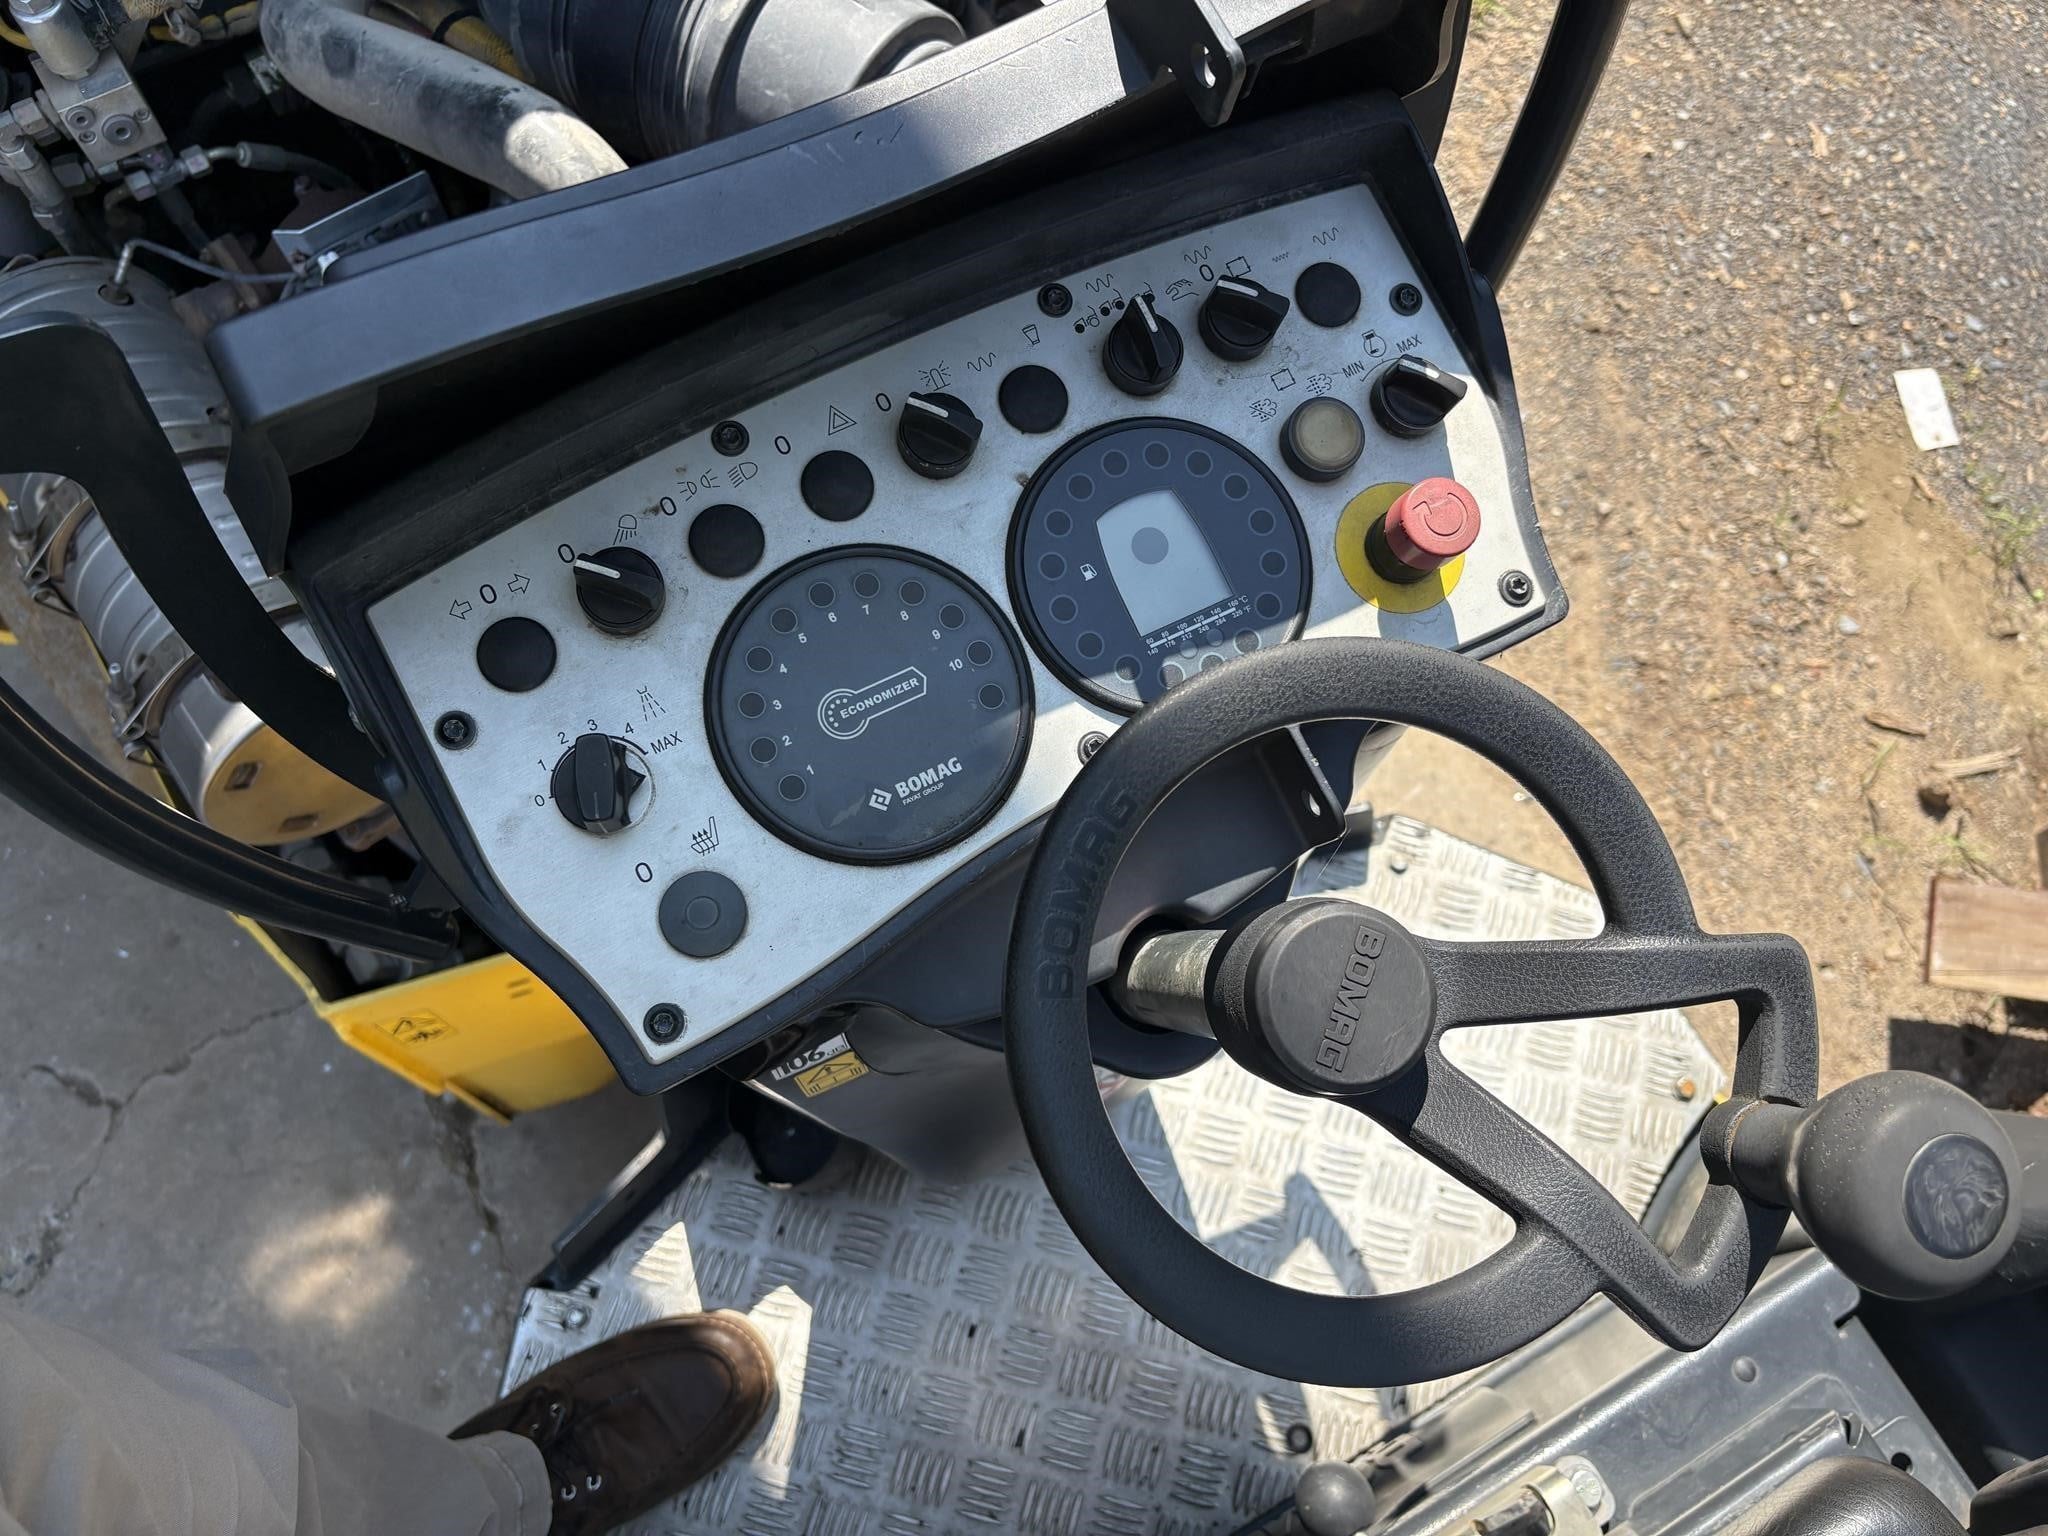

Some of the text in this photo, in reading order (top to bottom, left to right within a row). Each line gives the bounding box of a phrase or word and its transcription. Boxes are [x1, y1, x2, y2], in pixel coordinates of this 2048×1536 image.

[1199, 264, 1215, 282] 0
[1396, 334, 1423, 353] MAX
[1342, 361, 1365, 378] MIN
[875, 392, 892, 412] 0
[774, 435, 791, 455] 0
[660, 496, 677, 516] 0
[558, 543, 576, 564] 0
[479, 583, 497, 605] 0
[828, 612, 837, 623] 6
[862, 605, 870, 616] 7
[900, 610, 909, 621] 8
[1177, 622, 1188, 631] 100
[1193, 615, 1205, 623] 120
[1210, 607, 1222, 616] 140
[1228, 600, 1239, 608] 160
[798, 633, 807, 644] 5
[932, 629, 941, 640] 9
[1147, 648, 1158, 656] 140
[1181, 632, 1192, 641] 212
[1198, 625, 1210, 634] 248
[779, 663, 788, 675] 4
[949, 658, 963, 671] 10
[773, 700, 782, 710] 3
[839, 677, 920, 719] ECONOMIZER
[587, 719, 598, 732] 3
[624, 722, 635, 735] 4
[557, 731, 570, 745] 2
[650, 731, 683, 755] MAX
[782, 735, 792, 746] 2
[538, 759, 547, 772] 1
[806, 765, 814, 775] 1
[894, 757, 963, 798] BOMAG
[534, 794, 546, 807] 0
[902, 782, 944, 805] FAYAT GROUP
[635, 862, 653, 883] 0
[1035, 788, 1139, 999] BOMAG
[1315, 925, 1387, 1073] BOMAG
